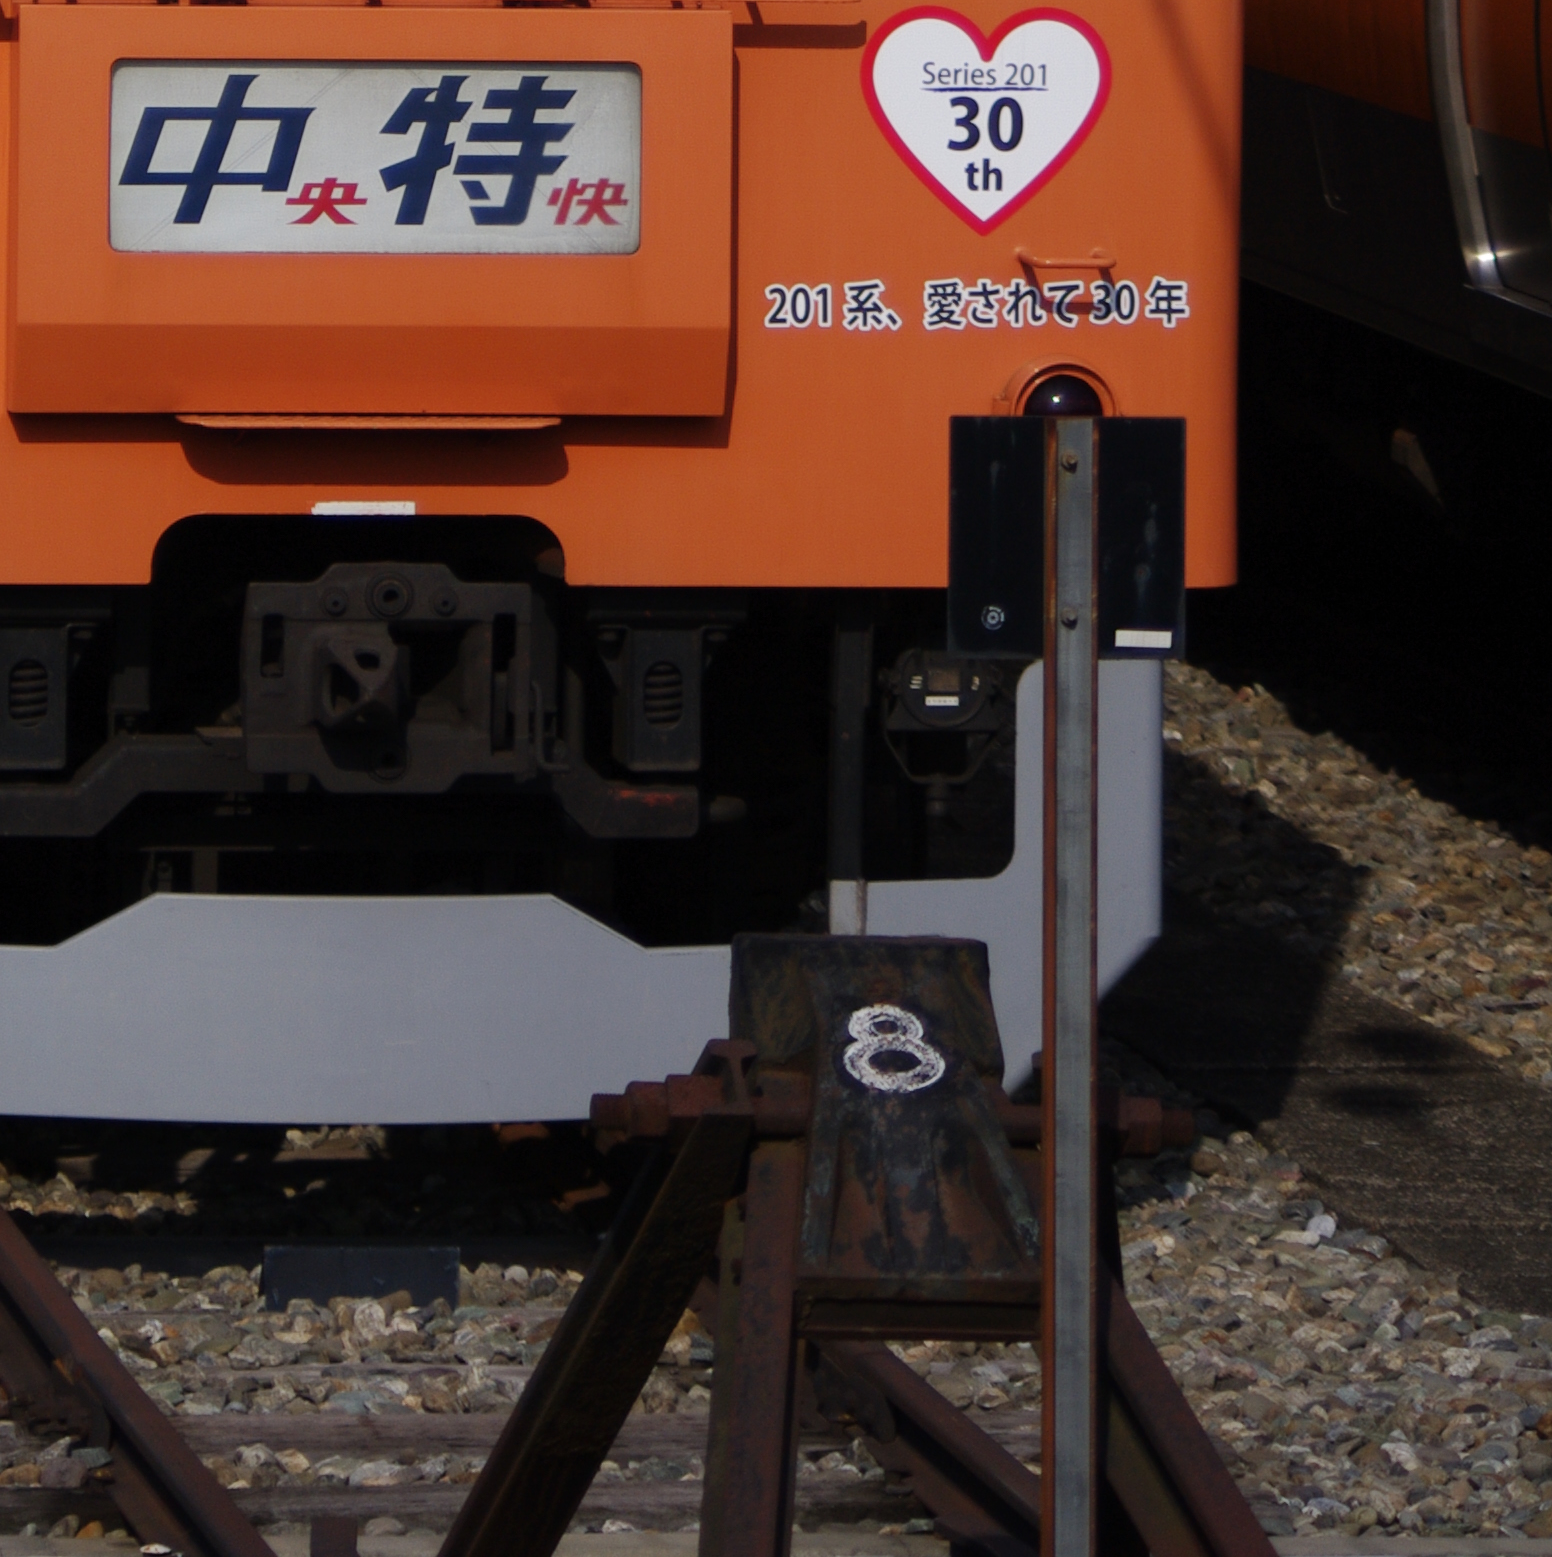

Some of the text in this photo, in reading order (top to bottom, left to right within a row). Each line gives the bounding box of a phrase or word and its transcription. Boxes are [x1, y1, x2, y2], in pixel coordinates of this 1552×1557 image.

[922, 61, 1047, 86] Series 201
[947, 95, 1024, 152] 30
[964, 157, 1003, 192] th
[843, 1004, 945, 1093] 8
